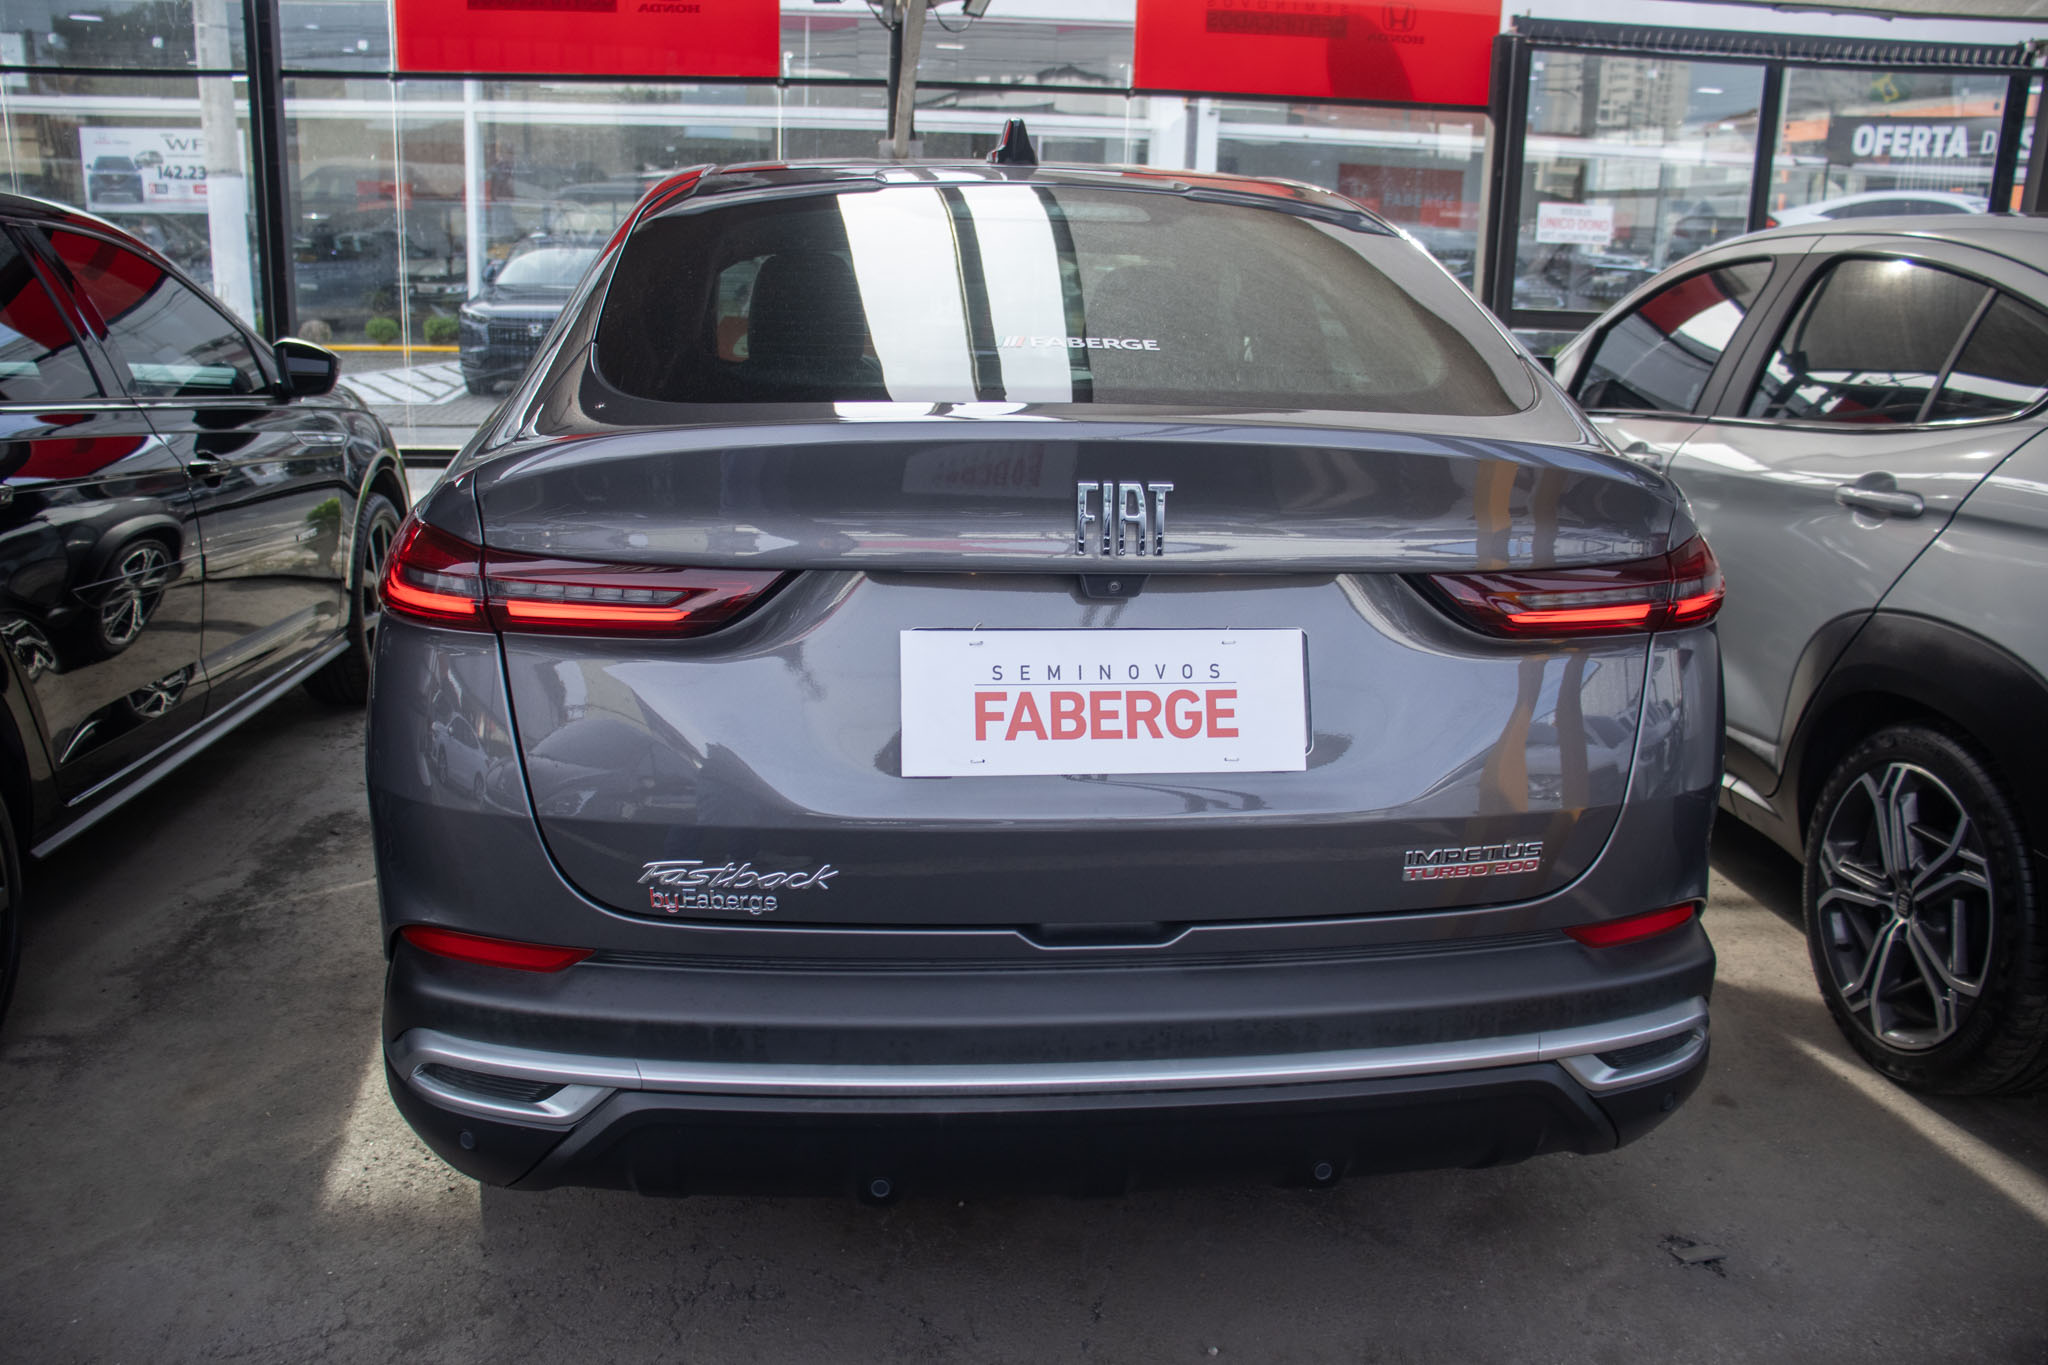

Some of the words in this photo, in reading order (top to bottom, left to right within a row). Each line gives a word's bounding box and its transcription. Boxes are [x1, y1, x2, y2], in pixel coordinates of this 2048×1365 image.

[1852, 124, 1969, 158] OFERTA
[1029, 336, 1161, 351] FABERGE
[1075, 480, 1175, 557] FIAT
[991, 664, 1221, 682] SEMINOVOS
[974, 689, 1239, 742] FABERGE
[1404, 841, 1544, 866] IMPETUS
[637, 860, 839, 890] Fastback
[1403, 864, 1488, 881] TURBO
[1495, 859, 1540, 875] 200
[649, 886, 680, 913] by
[682, 888, 779, 915] Faberge
